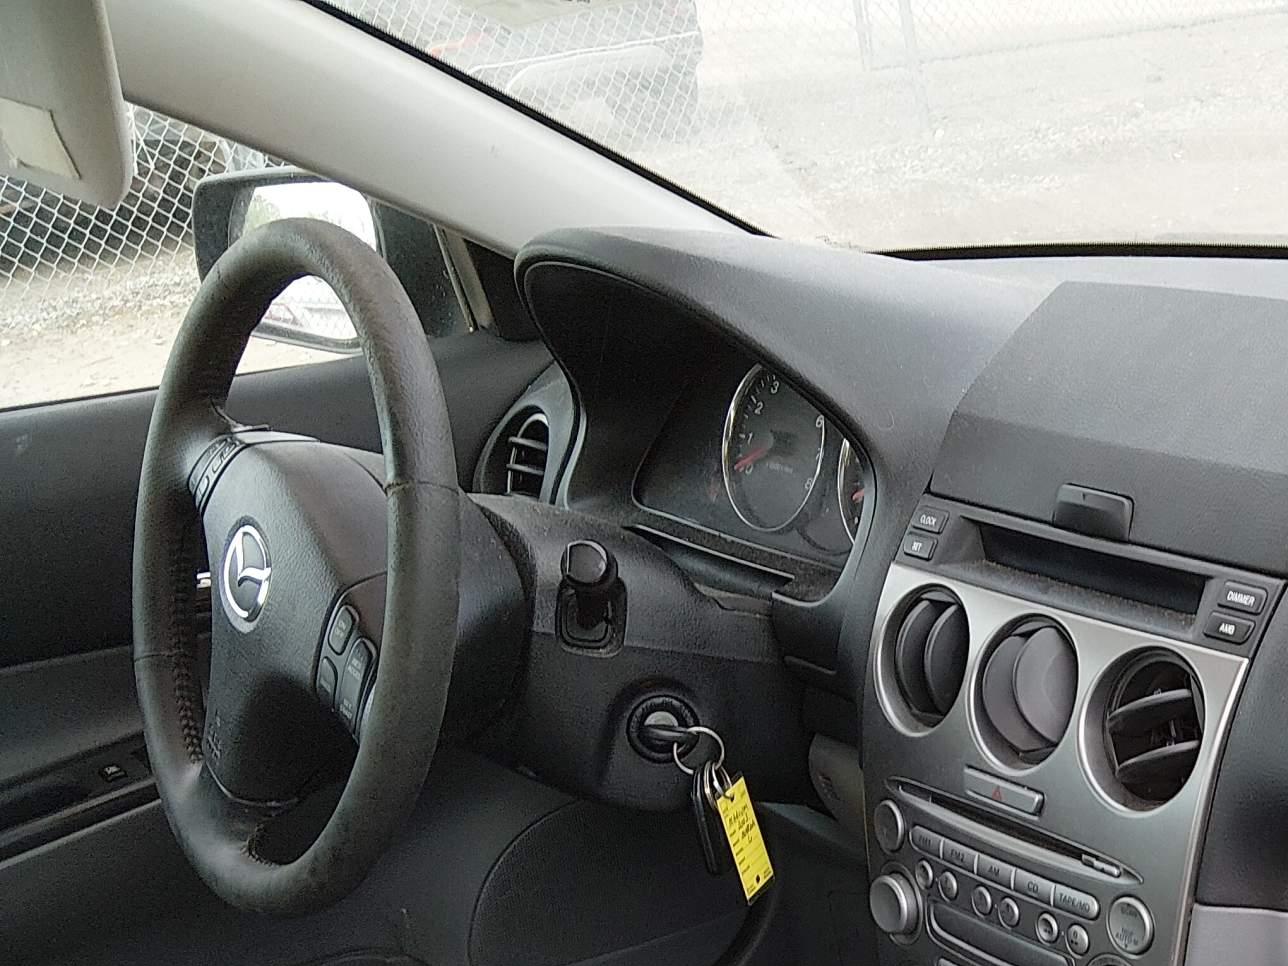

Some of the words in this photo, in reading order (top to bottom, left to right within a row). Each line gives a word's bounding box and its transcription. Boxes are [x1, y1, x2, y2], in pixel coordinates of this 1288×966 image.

[1227, 590, 1255, 607] DIMMER
[988, 866, 1000, 878] AM
[1027, 881, 1039, 893] CD
